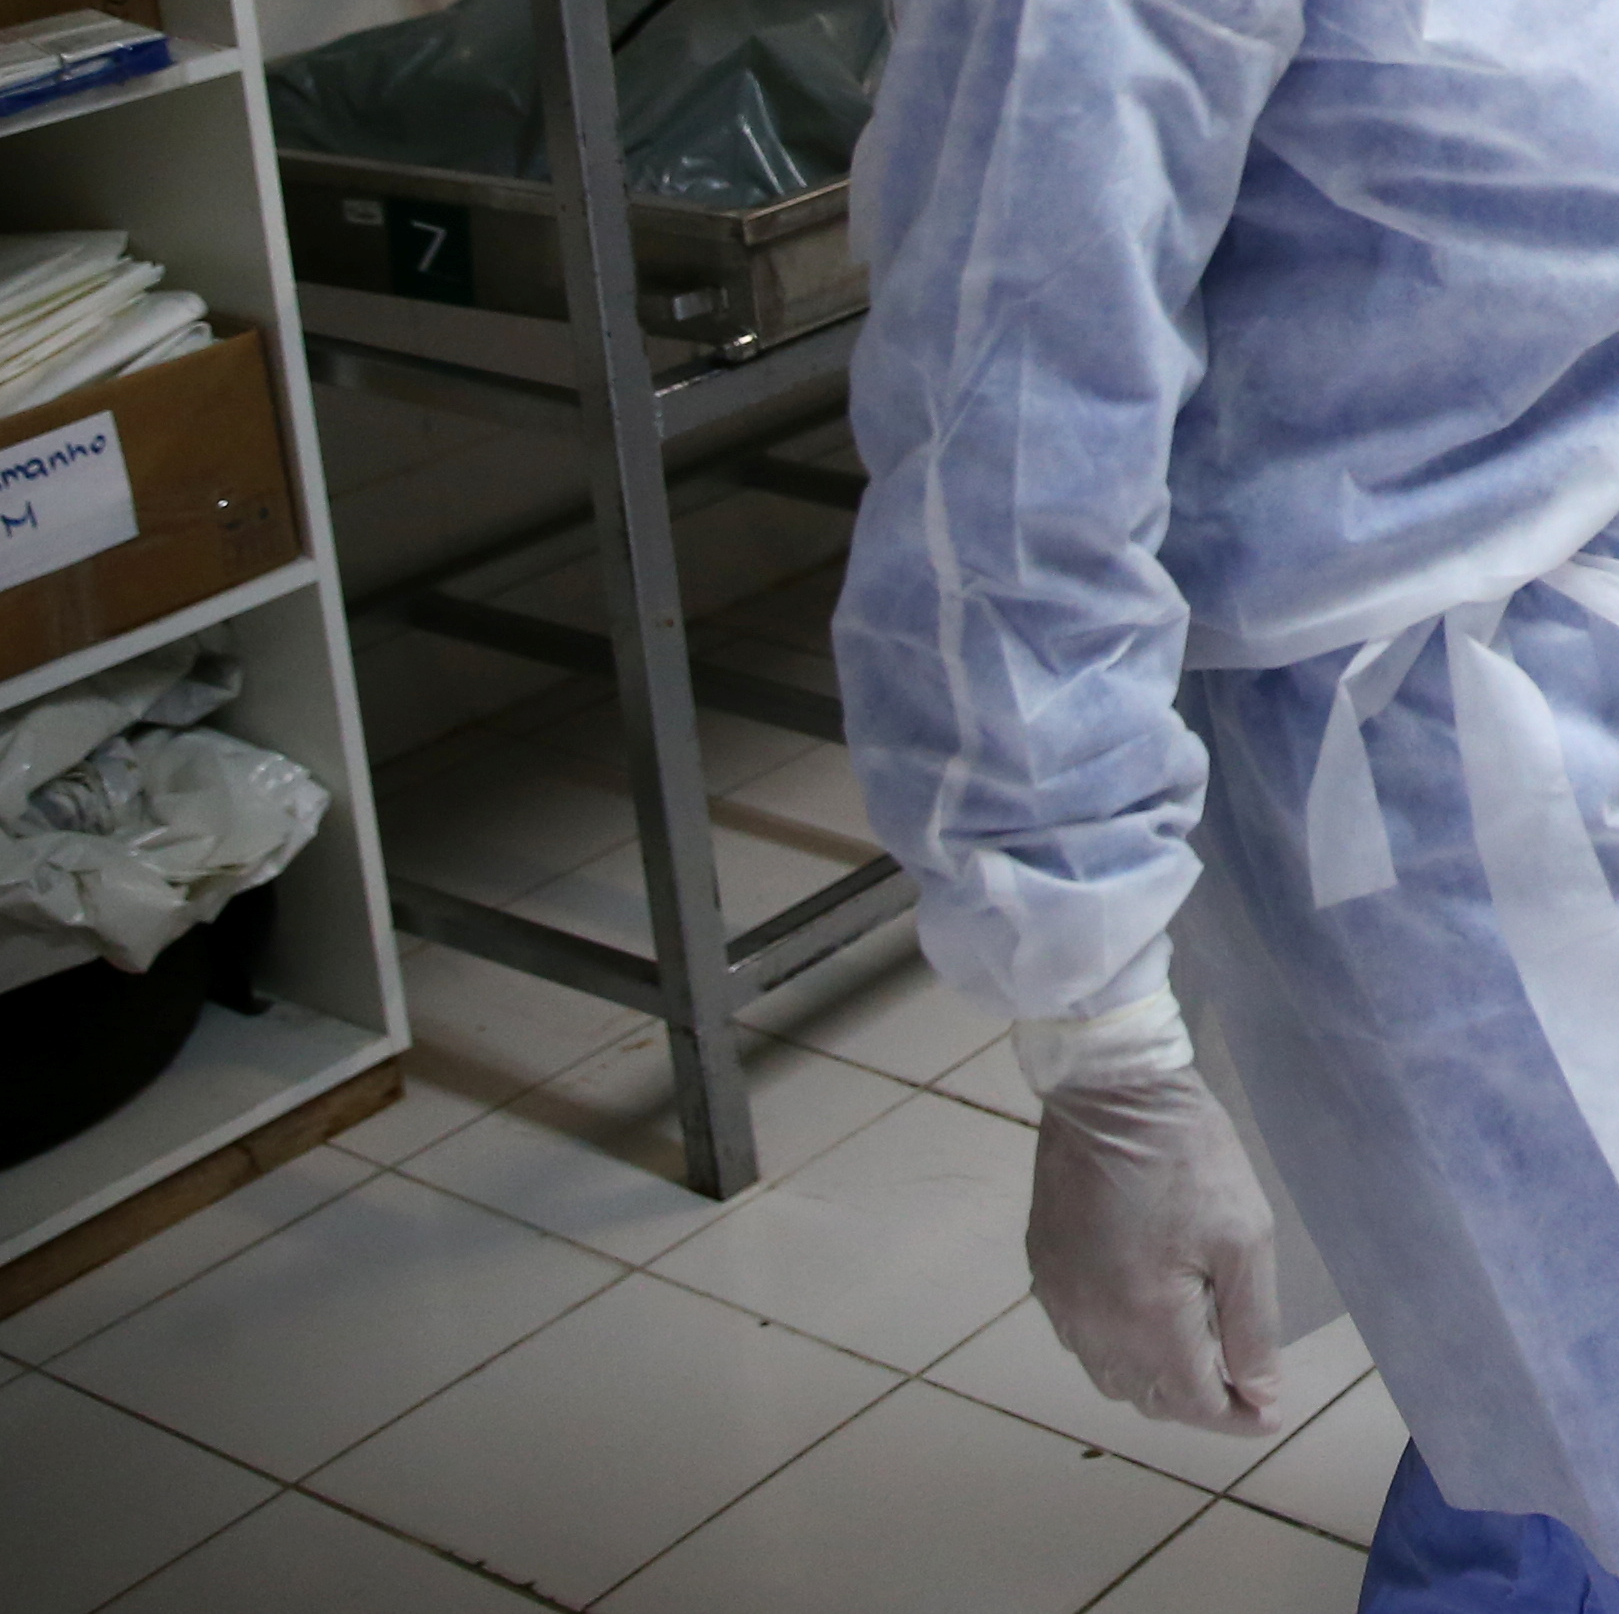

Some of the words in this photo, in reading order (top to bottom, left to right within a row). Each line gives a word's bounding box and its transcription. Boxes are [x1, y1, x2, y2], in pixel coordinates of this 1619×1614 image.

[410, 220, 447, 273] 7
[0, 434, 107, 492] manho
[0, 500, 39, 538] M
